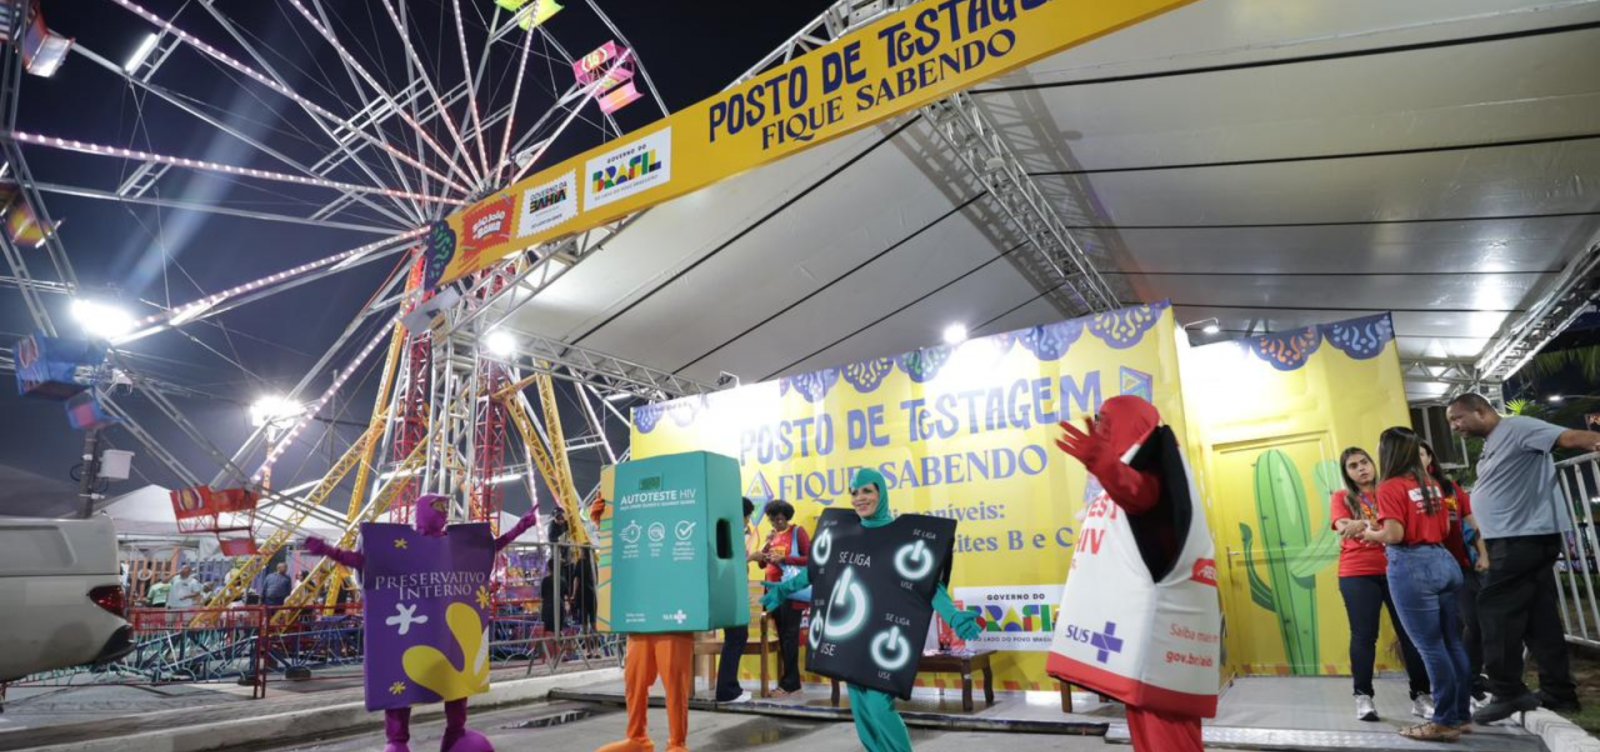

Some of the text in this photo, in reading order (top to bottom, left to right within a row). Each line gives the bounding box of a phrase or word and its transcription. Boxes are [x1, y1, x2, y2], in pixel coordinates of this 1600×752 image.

[709, 65, 808, 143] POSTO
[822, 40, 867, 96] DE
[762, 28, 1016, 150] FIQUE SABENDO
[592, 148, 662, 194] BRASIL
[740, 413, 834, 466] POSTO
[847, 404, 890, 450] DE
[879, 444, 1048, 490] SABENDO
[620, 490, 678, 506] AUTOTESTE
[680, 488, 696, 499] HIV
[1008, 530, 1024, 550] B
[1032, 533, 1046, 548] e
[1055, 527, 1074, 547] C
[840, 551, 871, 568] SE LIGA
[375, 571, 485, 590] PRESERVATIVO
[901, 581, 914, 590] USE
[400, 583, 472, 600] INTERNO
[987, 593, 1029, 601] GOVERNO
[1066, 624, 1090, 643] SUS
